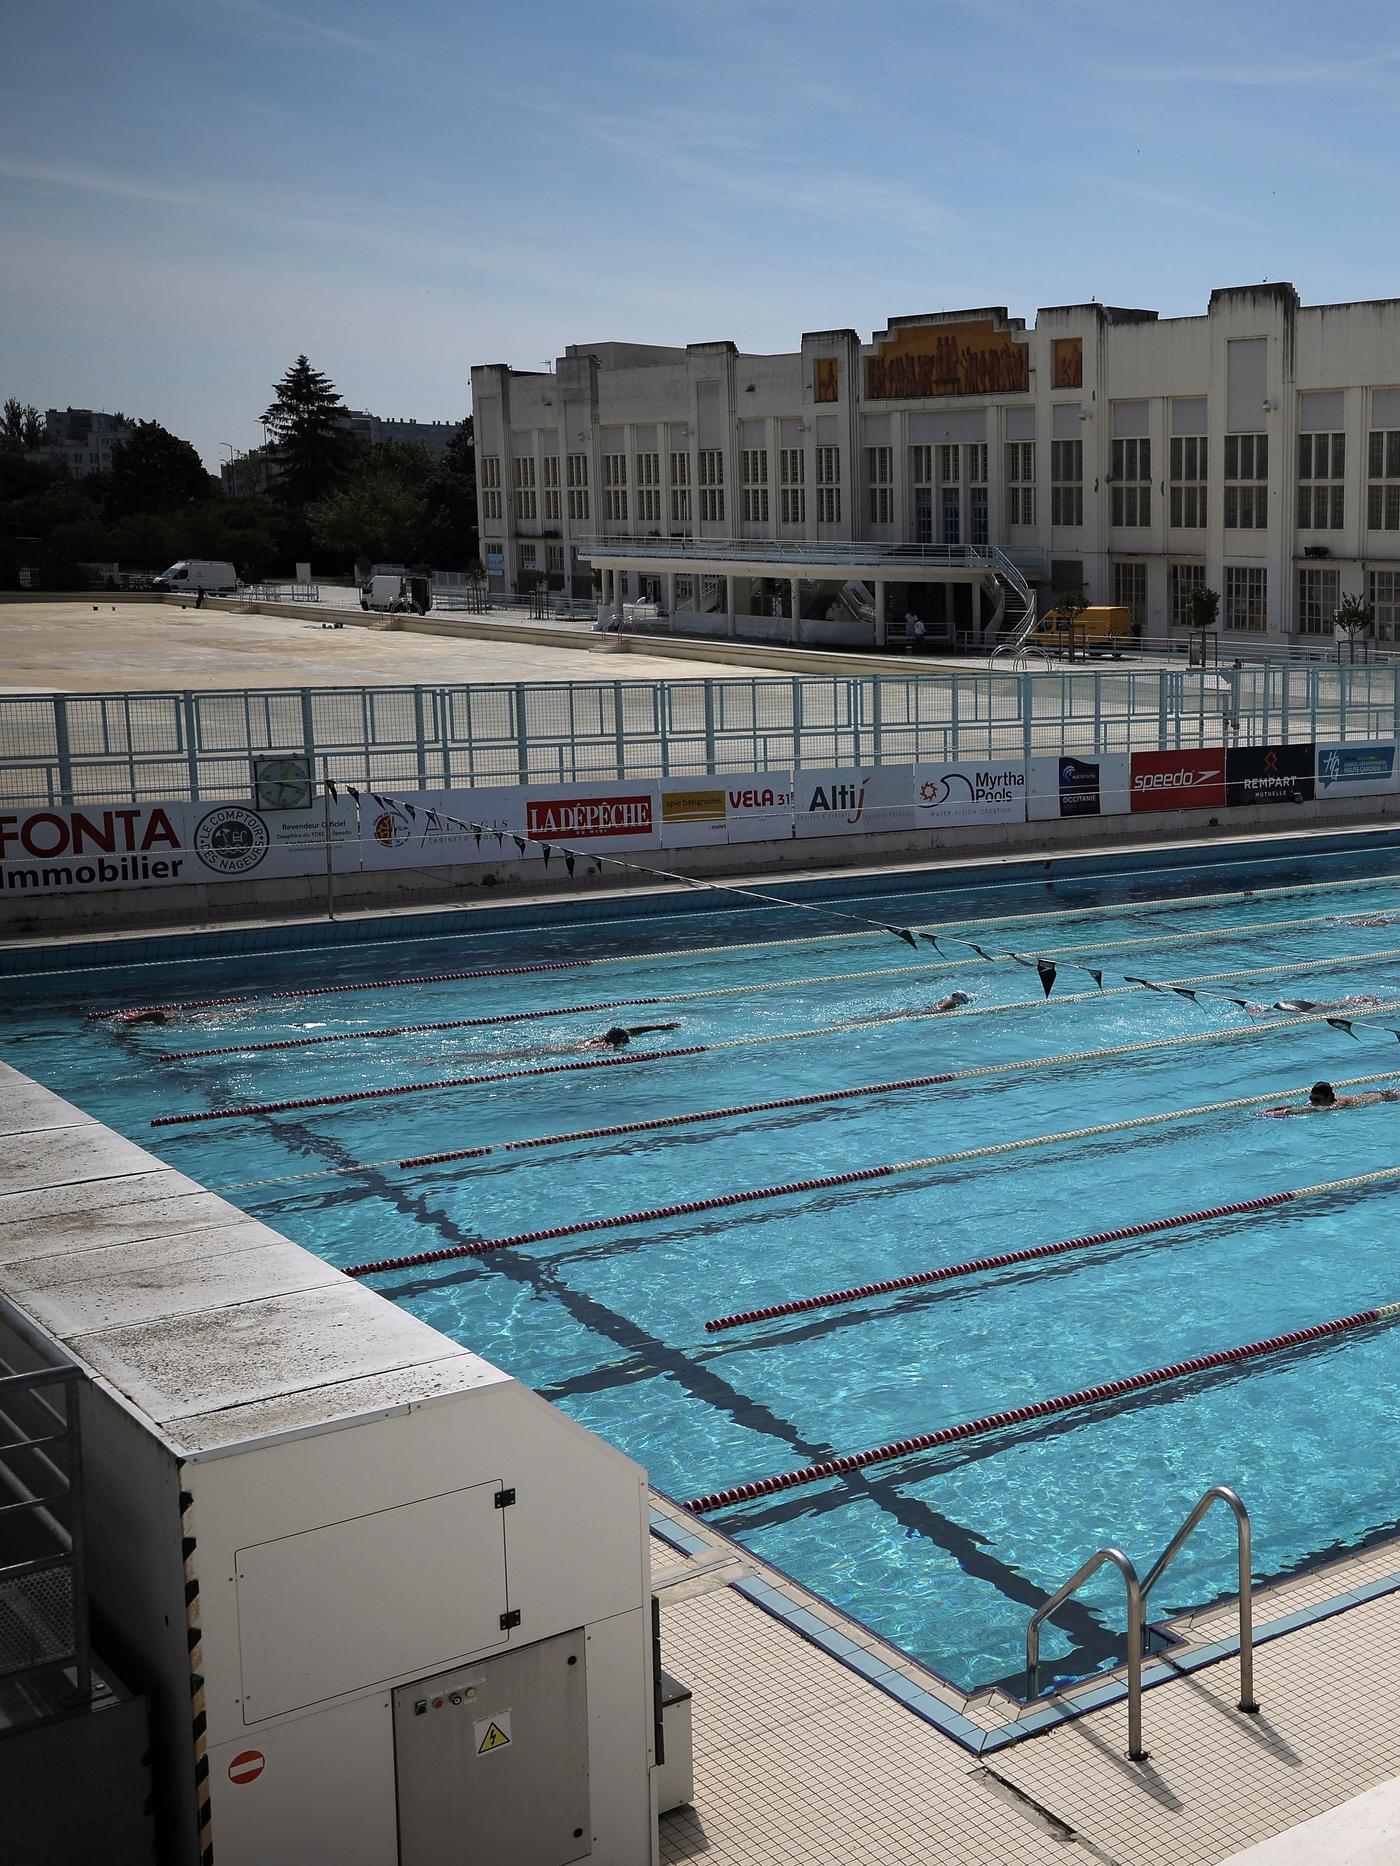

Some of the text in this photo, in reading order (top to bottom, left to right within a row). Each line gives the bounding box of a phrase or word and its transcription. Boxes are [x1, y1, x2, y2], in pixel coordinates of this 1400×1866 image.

[976, 771, 1025, 790] Myrtha
[1134, 768, 1193, 792] speedo
[1244, 776, 1297, 790] REMPART
[729, 788, 791, 809] VELA 31
[976, 788, 1012, 803] Pools
[1063, 794, 1097, 805] OCCITANIE
[1255, 789, 1287, 798] MUTUELLE
[200, 810, 264, 839] LE COMPTOIR
[282, 819, 346, 831] Revendeur Oficiel
[559, 801, 650, 832] DÉPÊCHE
[0, 808, 182, 860] FONTA
[200, 840, 264, 871] DES NAGEURS
